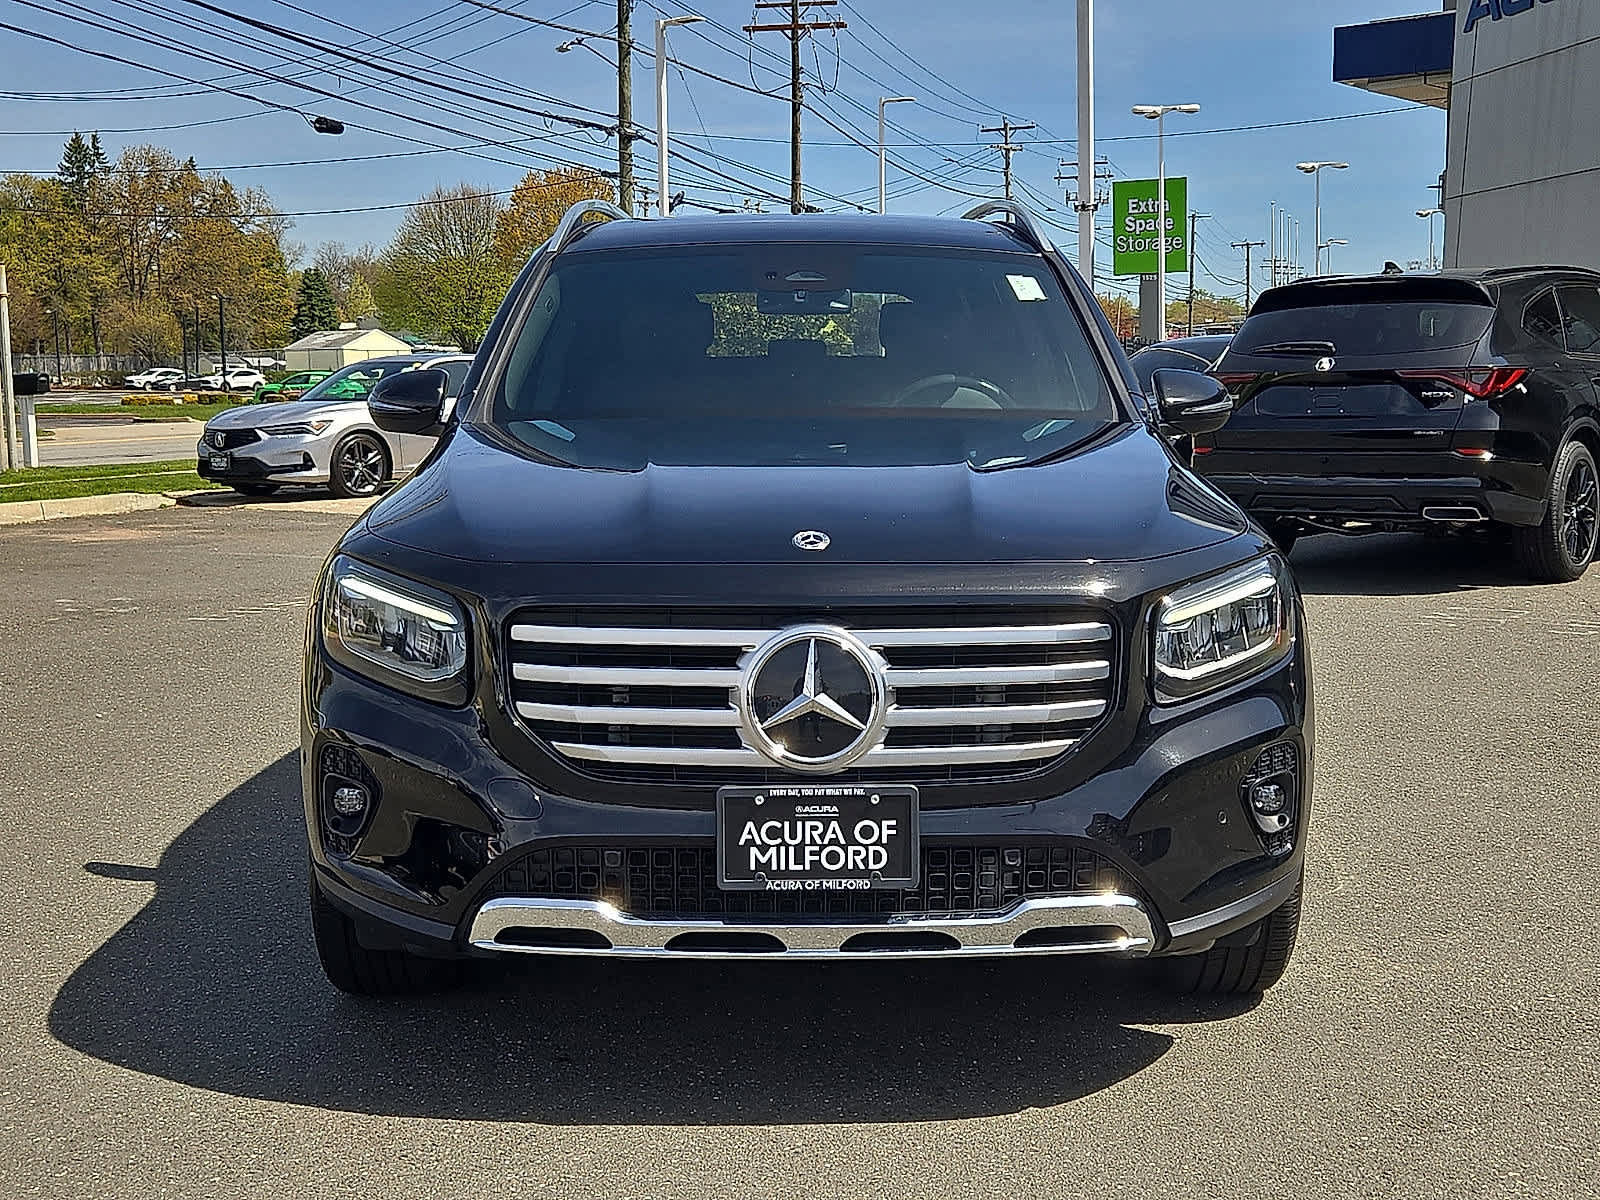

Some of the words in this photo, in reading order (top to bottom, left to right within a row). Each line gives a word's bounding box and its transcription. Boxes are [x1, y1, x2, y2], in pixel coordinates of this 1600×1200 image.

[1116, 235, 1183, 252] Storage
[801, 788, 814, 796] YOU
[826, 788, 842, 796] WHAT
[803, 805, 839, 813] ACURA
[738, 820, 846, 846] ACURA
[853, 819, 897, 845] OF
[750, 845, 888, 871] MILFORD
[765, 880, 803, 891] ACURA
[804, 880, 821, 890] OF
[822, 879, 871, 890] MILFORD
